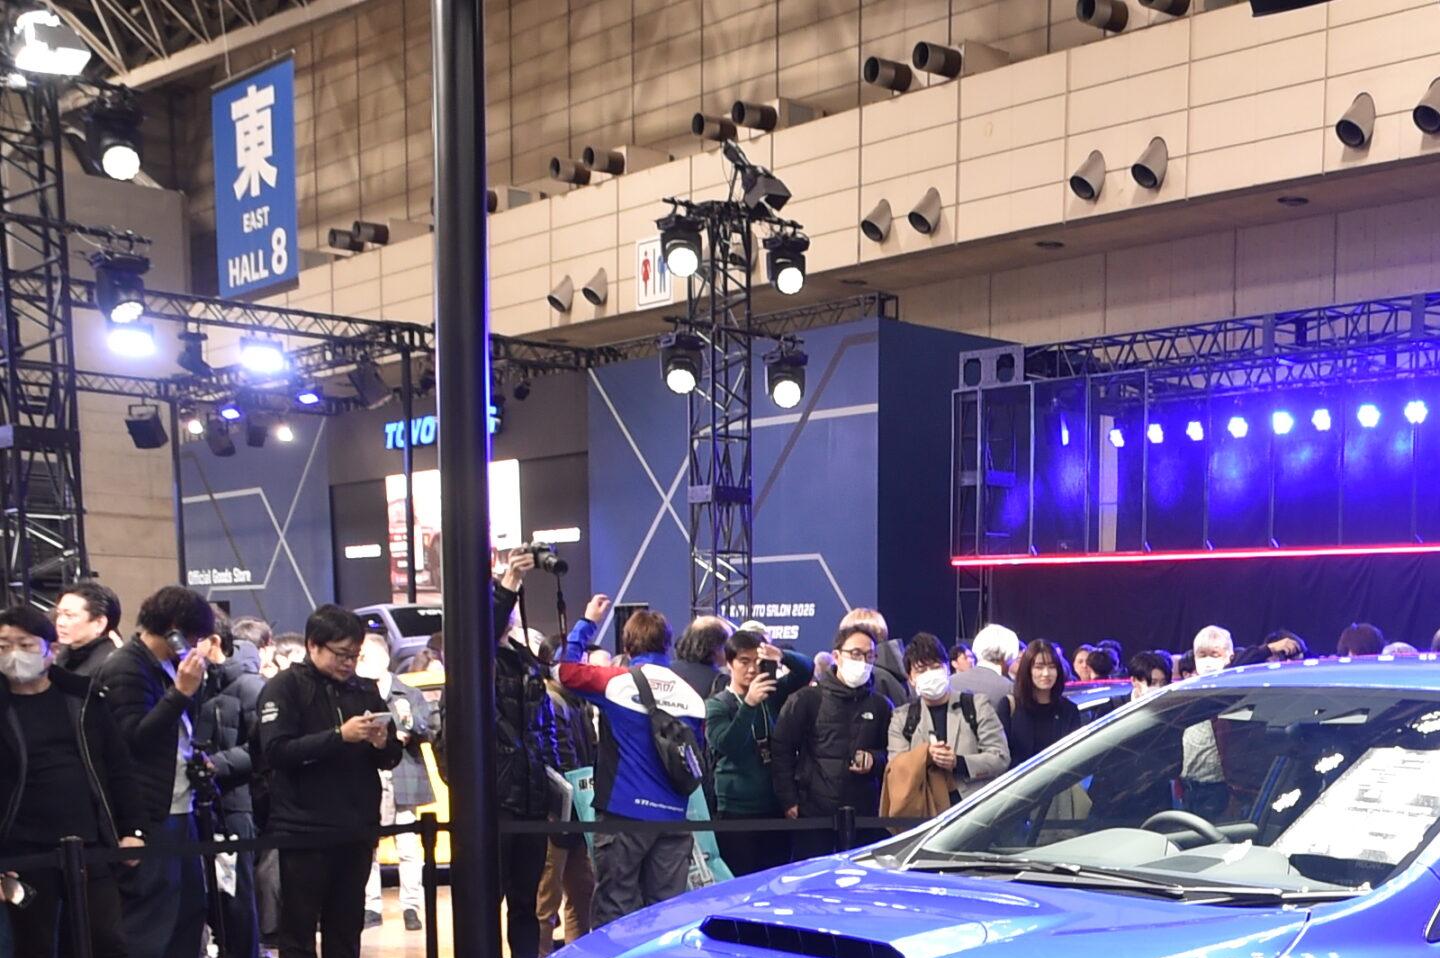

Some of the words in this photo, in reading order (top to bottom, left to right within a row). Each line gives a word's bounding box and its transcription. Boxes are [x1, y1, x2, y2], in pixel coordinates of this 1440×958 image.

[231, 84, 278, 200] 東
[242, 206, 270, 234] EAST
[228, 249, 269, 288] HALL
[271, 226, 288, 276] 8
[212, 568, 232, 583] Goods
[233, 567, 251, 582] Store
[792, 603, 816, 617] 2026
